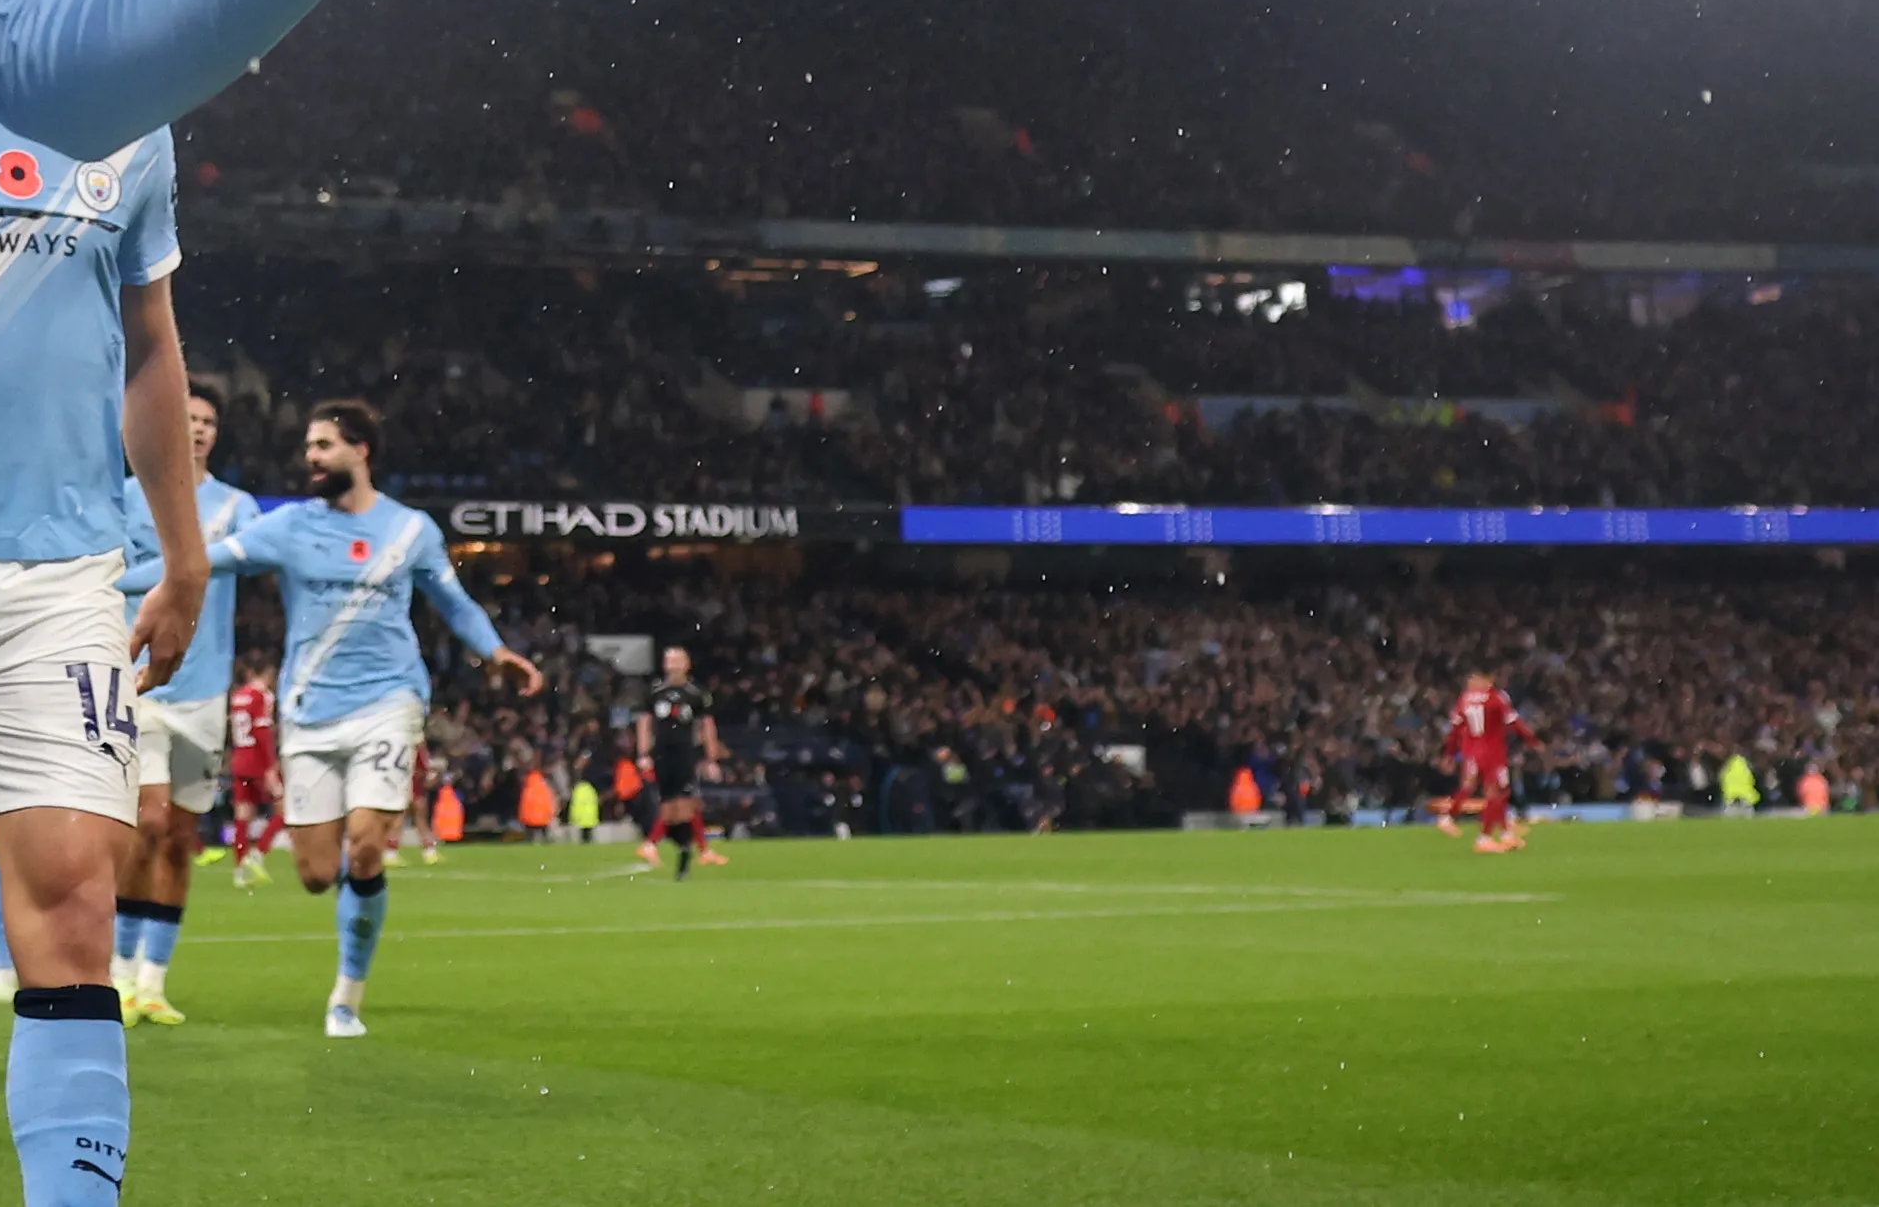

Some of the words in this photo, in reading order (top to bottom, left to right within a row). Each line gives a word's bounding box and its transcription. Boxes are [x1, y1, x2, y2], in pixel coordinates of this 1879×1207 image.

[450, 501, 648, 537] ETIHAD
[652, 503, 800, 537] STADIUM
[65, 662, 139, 744] 14
[373, 739, 411, 774] 24
